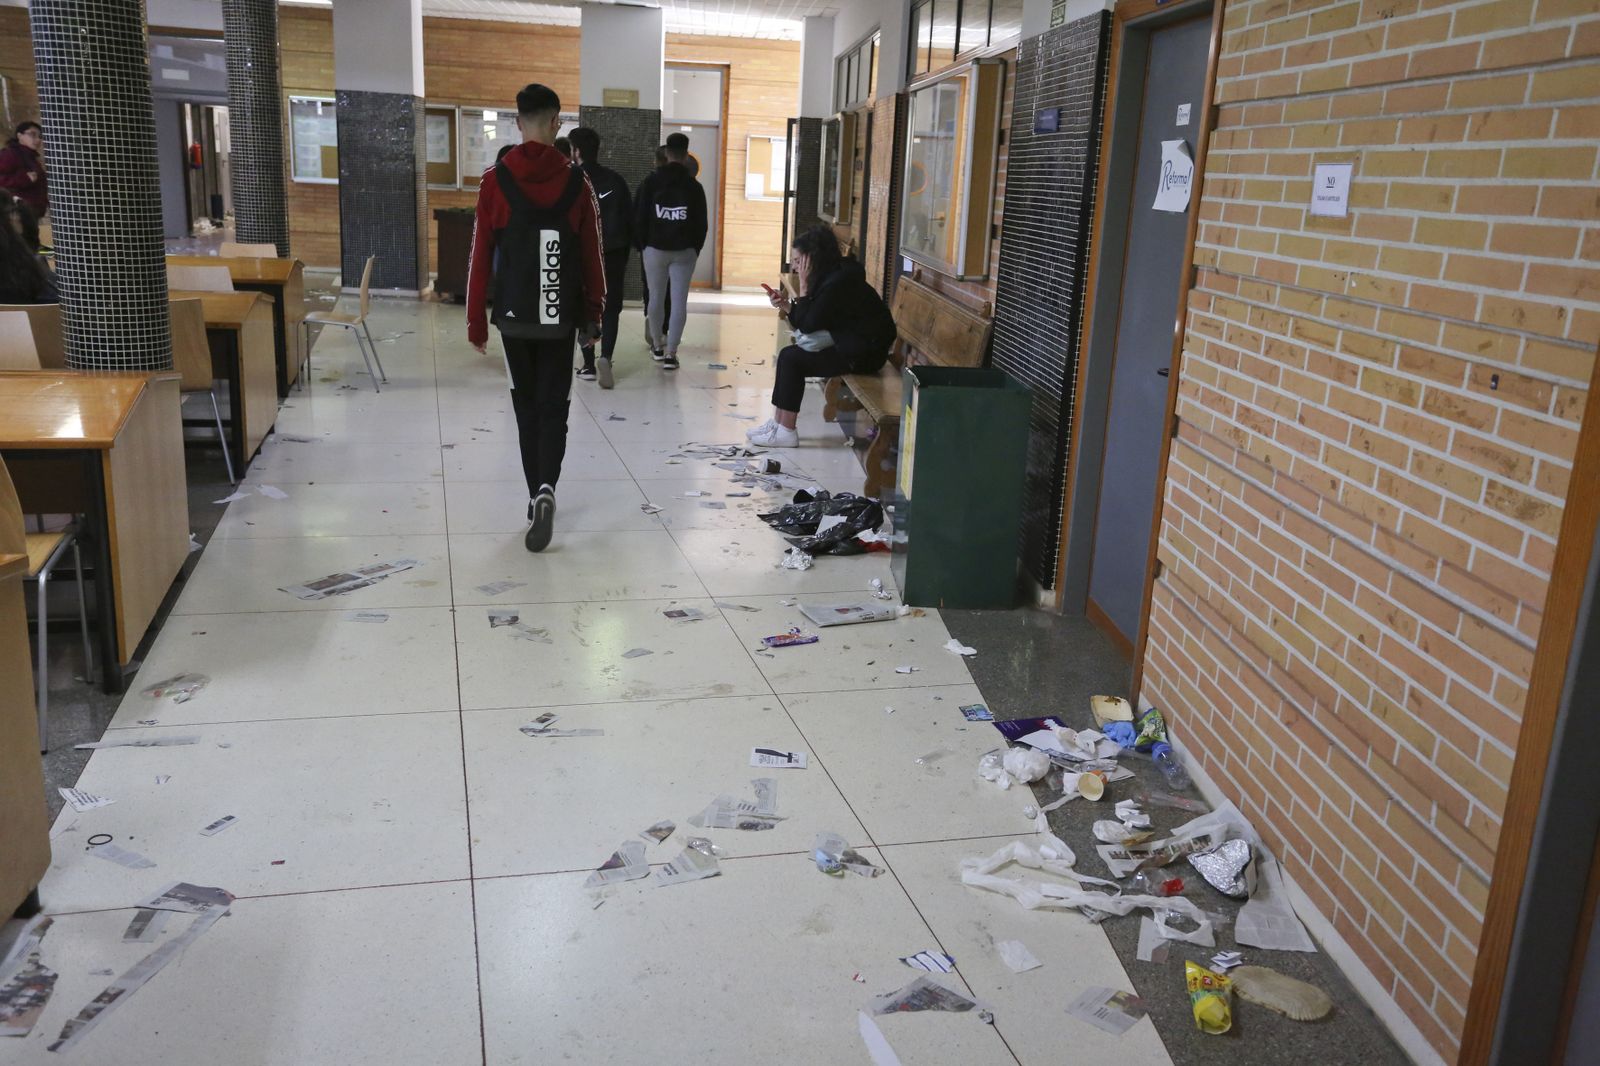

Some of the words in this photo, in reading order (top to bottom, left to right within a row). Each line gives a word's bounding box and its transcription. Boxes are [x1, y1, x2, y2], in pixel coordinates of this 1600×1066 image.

[1326, 176, 1336, 186] NO
[655, 203, 688, 221] VANS
[542, 240, 560, 318] adidas
